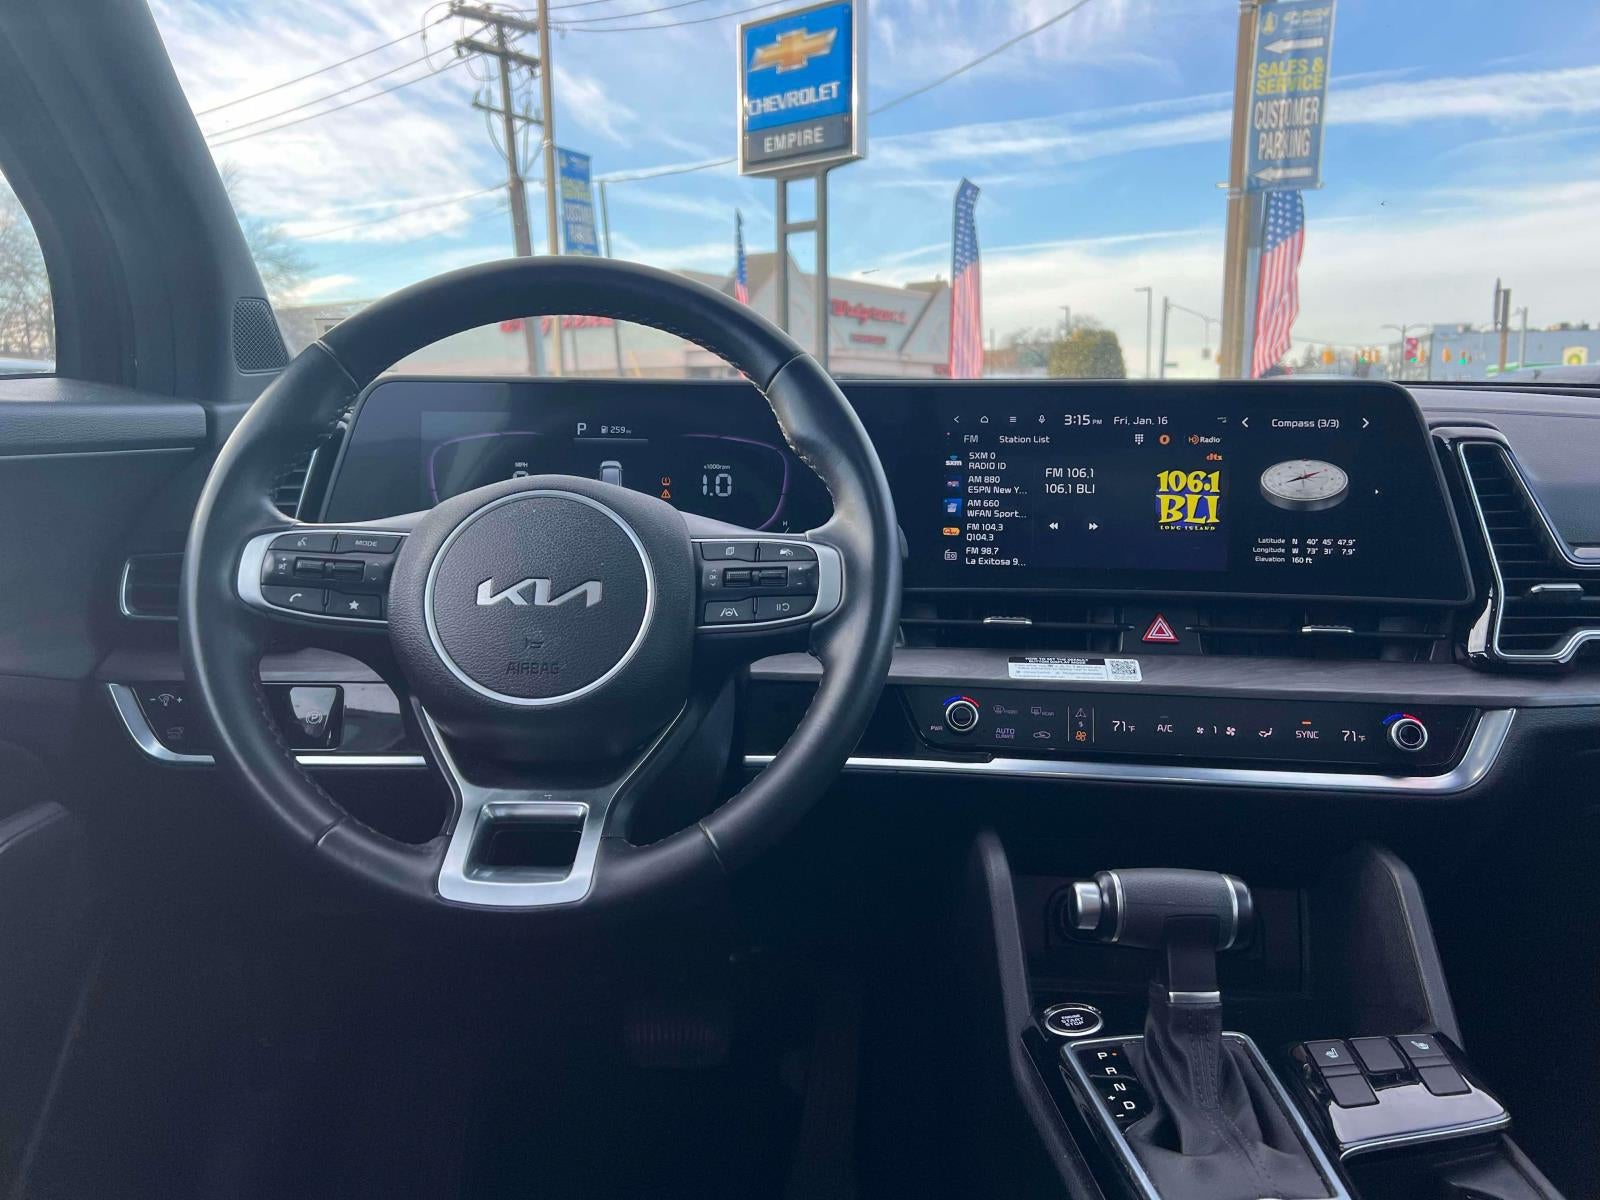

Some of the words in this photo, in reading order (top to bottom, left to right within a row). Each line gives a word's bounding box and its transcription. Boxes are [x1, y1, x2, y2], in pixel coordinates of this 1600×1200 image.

[1257, 58, 1308, 78] SALES
[1312, 56, 1325, 74] &
[1256, 74, 1323, 95] SERVICE
[748, 81, 840, 116] CHEVROLET
[1254, 97, 1320, 130] CUSTOMER
[764, 127, 824, 152] EMPIRE
[1258, 130, 1311, 160] PARKING
[1064, 414, 1091, 426] 3:15
[1157, 416, 1168, 425] 16
[1271, 418, 1315, 428] Compass
[1317, 418, 1340, 429] (3/3)
[577, 422, 587, 435] P
[610, 426, 626, 434] 259
[963, 434, 979, 443] FM
[999, 435, 1031, 443] Station
[1033, 435, 1050, 443] List
[968, 462, 995, 470] RADIO
[998, 462, 1007, 470] ID
[1045, 468, 1063, 478] FM
[1067, 468, 1094, 478] 106.1
[702, 474, 732, 497] 1.0
[1156, 470, 1220, 493] 106.1
[968, 486, 991, 494] ESPN
[993, 486, 1012, 494] New
[1045, 484, 1072, 494] 106.1
[1076, 484, 1095, 494] BLI
[1156, 493, 1220, 524] BLI
[966, 523, 980, 531] FM
[982, 523, 1004, 531] 104.3
[966, 533, 994, 542] Q104.3
[965, 547, 979, 555] FM
[980, 547, 999, 555] 98.7
[1253, 546, 1286, 554] Longitude
[978, 557, 1011, 565] Exitosa
[476, 577, 603, 608] KIA
[506, 662, 560, 674] AIRBAG
[1157, 724, 1173, 732] A/C
[1295, 730, 1320, 739] SYNC
[1097, 1052, 1108, 1060] P
[1105, 1066, 1118, 1075] R
[1113, 1083, 1127, 1091] N
[1123, 1101, 1136, 1110] D
